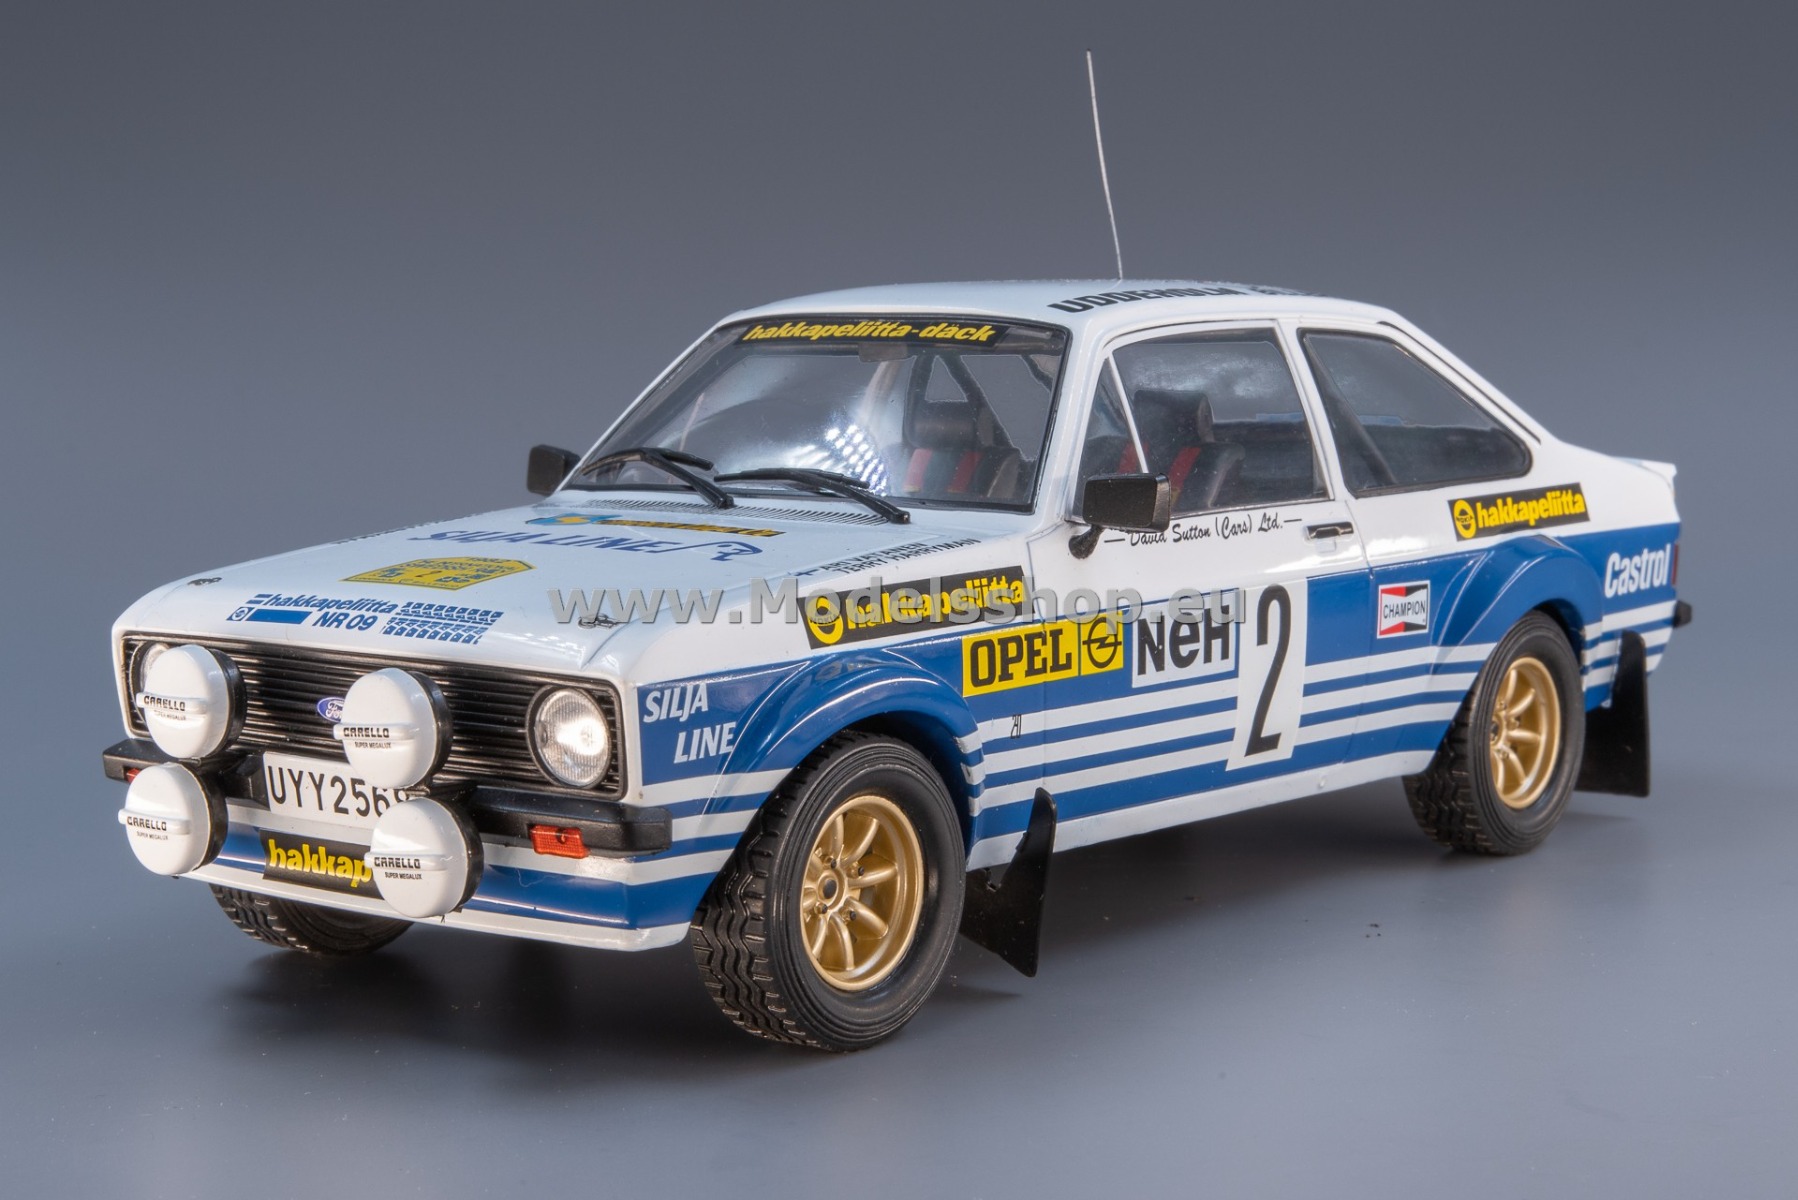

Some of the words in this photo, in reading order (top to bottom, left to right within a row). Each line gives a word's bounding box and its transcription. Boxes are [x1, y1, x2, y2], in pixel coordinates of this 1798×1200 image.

[743, 321, 996, 342] hakkapeliitta-däck
[1476, 490, 1587, 528] hakkapeliitta
[1171, 523, 1212, 543] Sutton
[1215, 514, 1253, 540] (Cars)
[1257, 512, 1284, 532] Ltd.
[832, 558, 888, 575] TERRY
[886, 537, 982, 562] HARRYMAN
[1603, 543, 1671, 598] Castrol
[263, 594, 399, 614] hakkapeliitta
[845, 575, 1025, 629] hakkapeliitta
[1382, 600, 1427, 619] CHAMPION
[312, 611, 349, 628] NR
[348, 614, 379, 631] 09
[970, 628, 1073, 688] OPEL
[1244, 584, 1292, 757] 2
[143, 695, 186, 712] CARELLO
[643, 682, 709, 723] SILJA
[343, 727, 390, 738] CARELLO
[673, 721, 737, 764] LINE
[267, 765, 408, 818] UYY256
[126, 816, 168, 832] CARELLO
[373, 857, 422, 870] CARELLO
